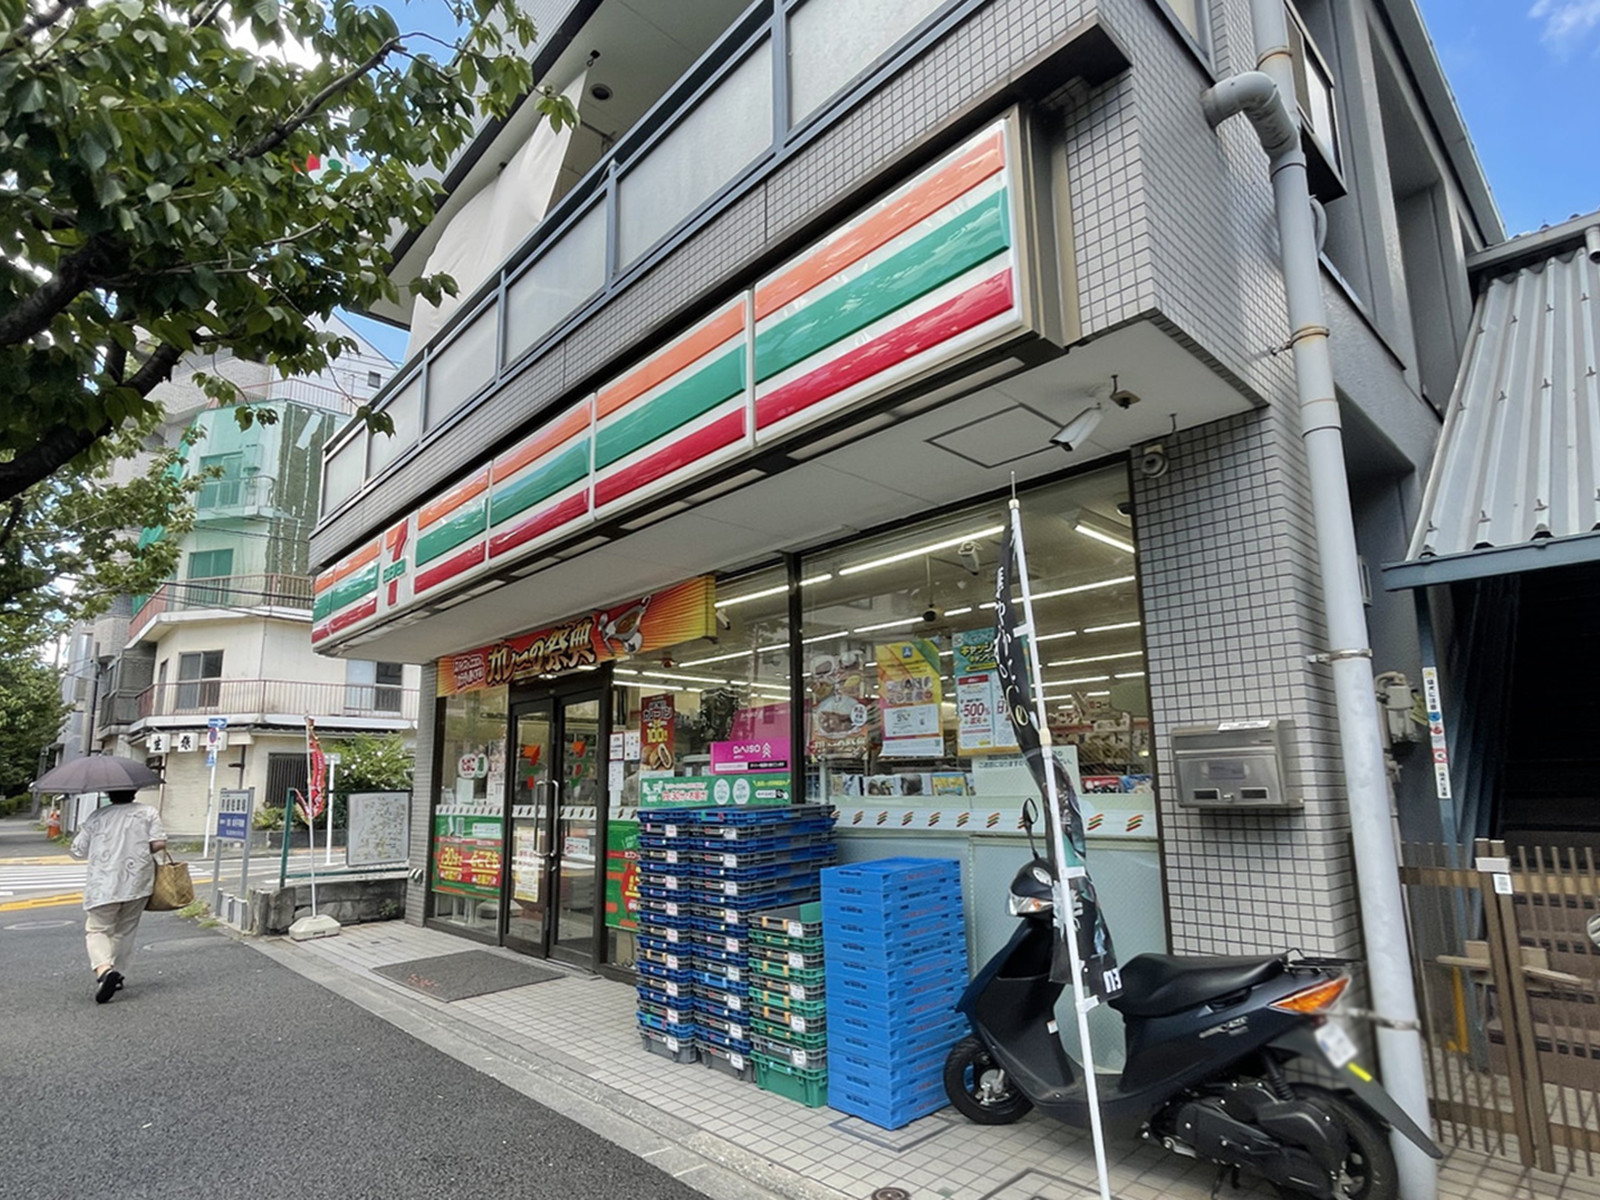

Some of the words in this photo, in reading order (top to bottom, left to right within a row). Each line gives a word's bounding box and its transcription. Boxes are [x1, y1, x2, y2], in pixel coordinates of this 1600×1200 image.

[487, 616, 596, 684] カレーの祭典
[733, 744, 761, 755] DAISO
